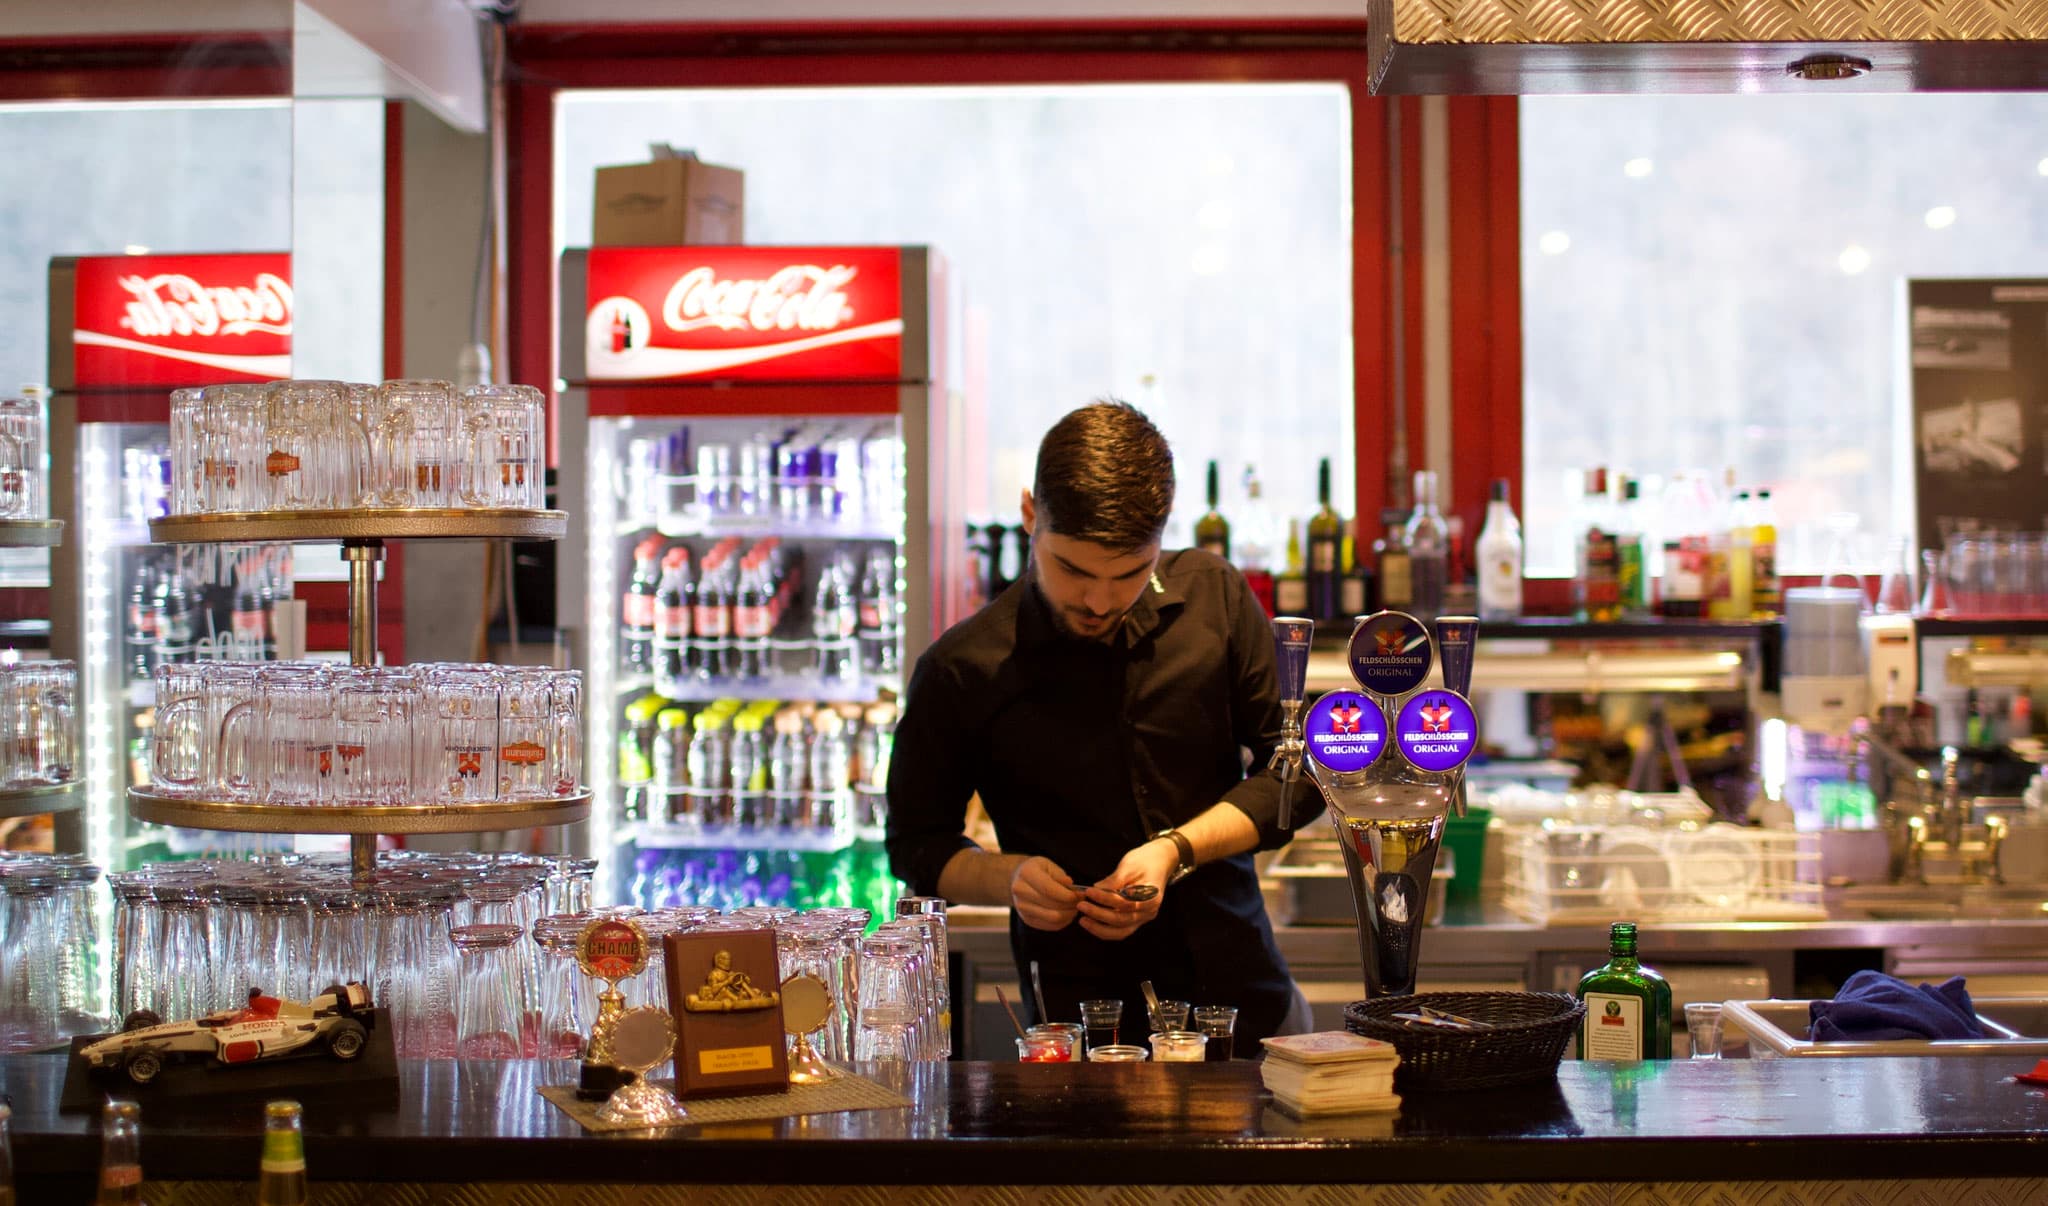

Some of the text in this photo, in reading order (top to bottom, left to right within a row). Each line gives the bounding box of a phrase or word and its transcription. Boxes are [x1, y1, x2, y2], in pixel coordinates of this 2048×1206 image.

[1359, 656, 1422, 665] FELDSCHLÖSSCHEN
[1368, 668, 1414, 677] ORIGINAL
[1323, 745, 1370, 755] ORIGINAL
[1413, 744, 1459, 754] ORIGINAL
[586, 941, 639, 956] CHAMP
[242, 1021, 288, 1030] HONDA
